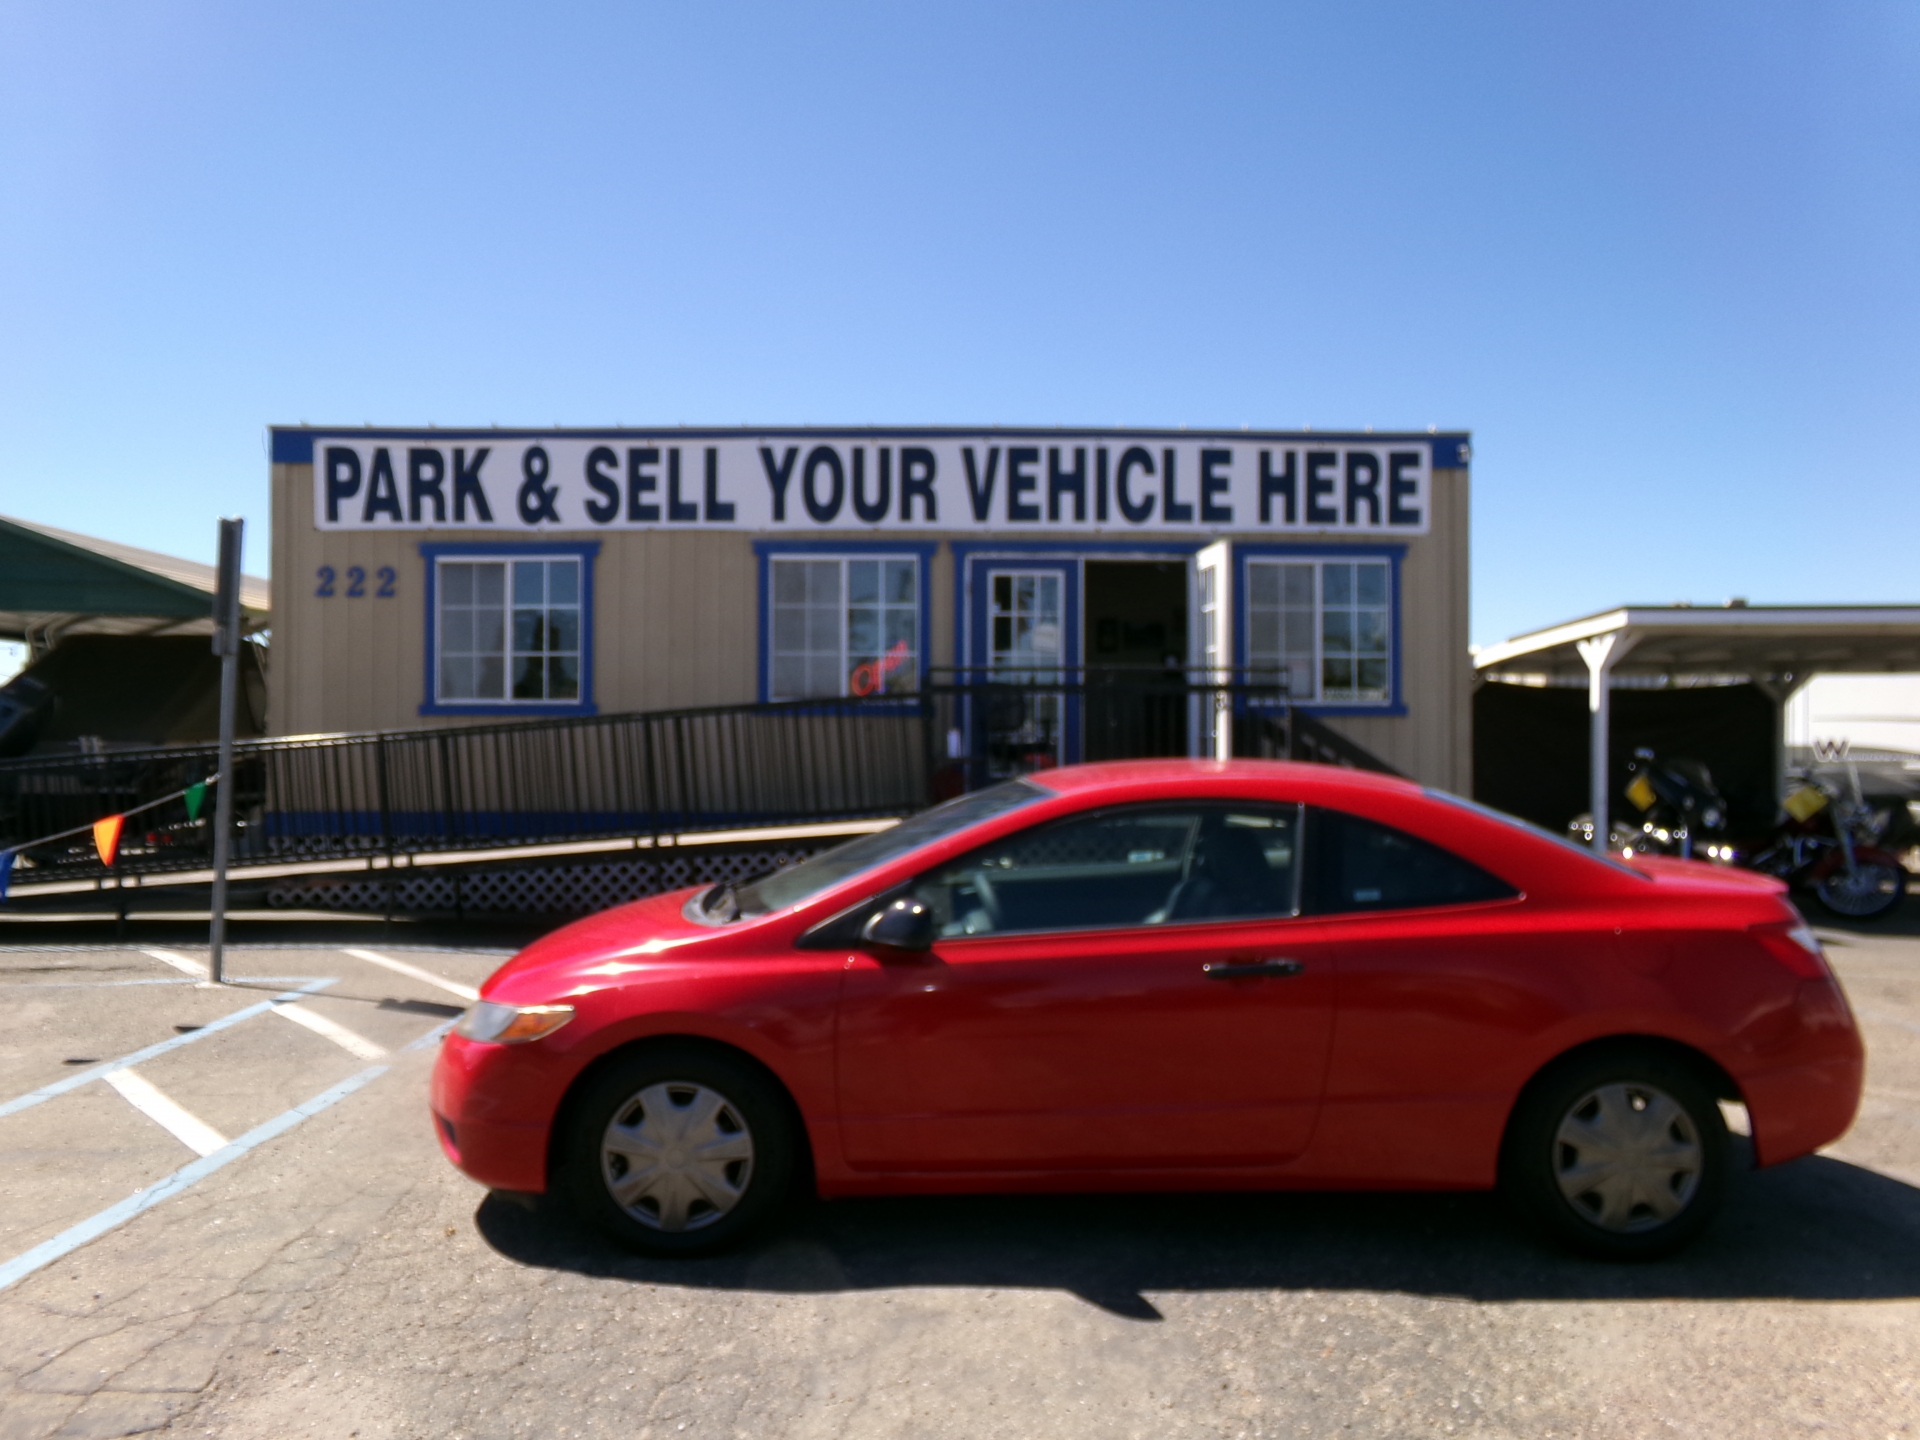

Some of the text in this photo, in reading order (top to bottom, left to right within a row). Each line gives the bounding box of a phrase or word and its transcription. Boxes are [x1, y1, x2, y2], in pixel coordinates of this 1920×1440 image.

[324, 444, 1422, 526] PARK & SELL YOUR VEHICLE HERE
